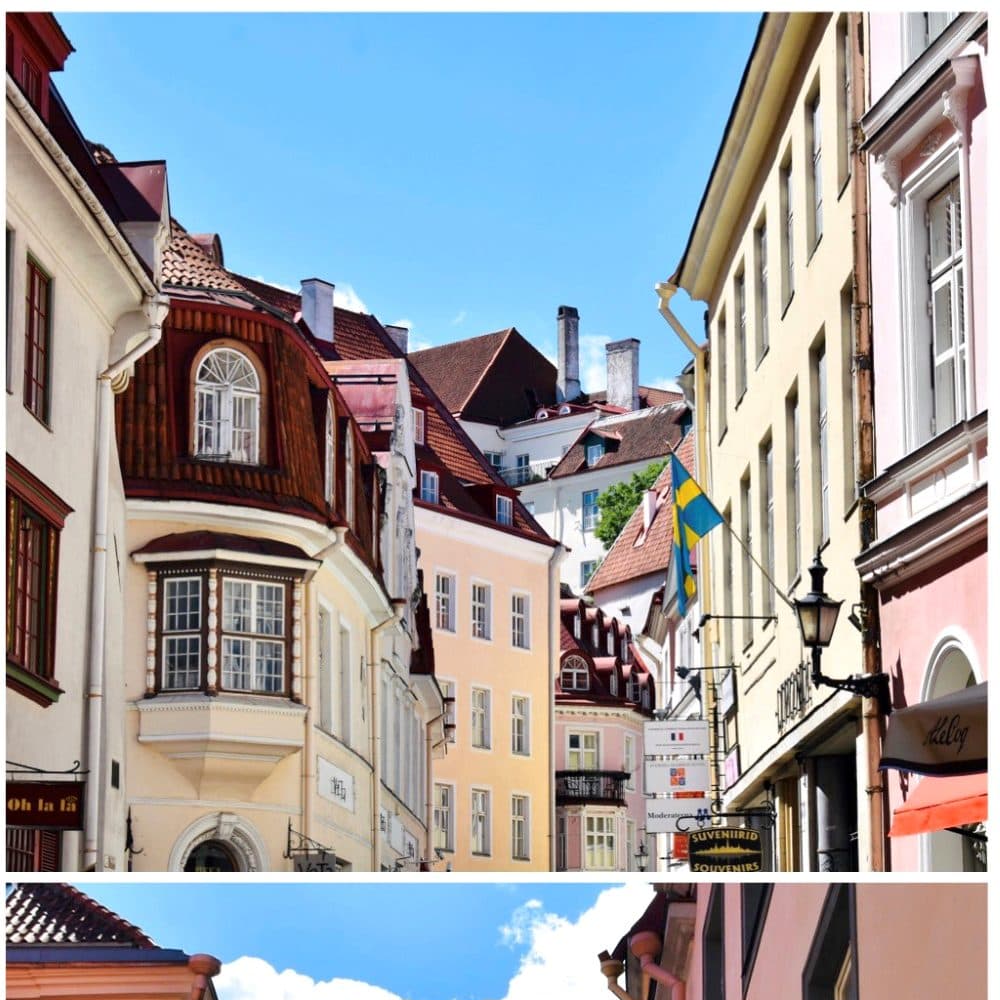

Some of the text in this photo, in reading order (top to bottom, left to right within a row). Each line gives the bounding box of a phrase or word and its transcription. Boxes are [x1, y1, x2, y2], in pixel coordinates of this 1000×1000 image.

[7, 798, 32, 811] Oh
[38, 798, 54, 812] la
[692, 830, 759, 842] SUVENIIRID
[694, 862, 760, 872] SOUVENIRS
